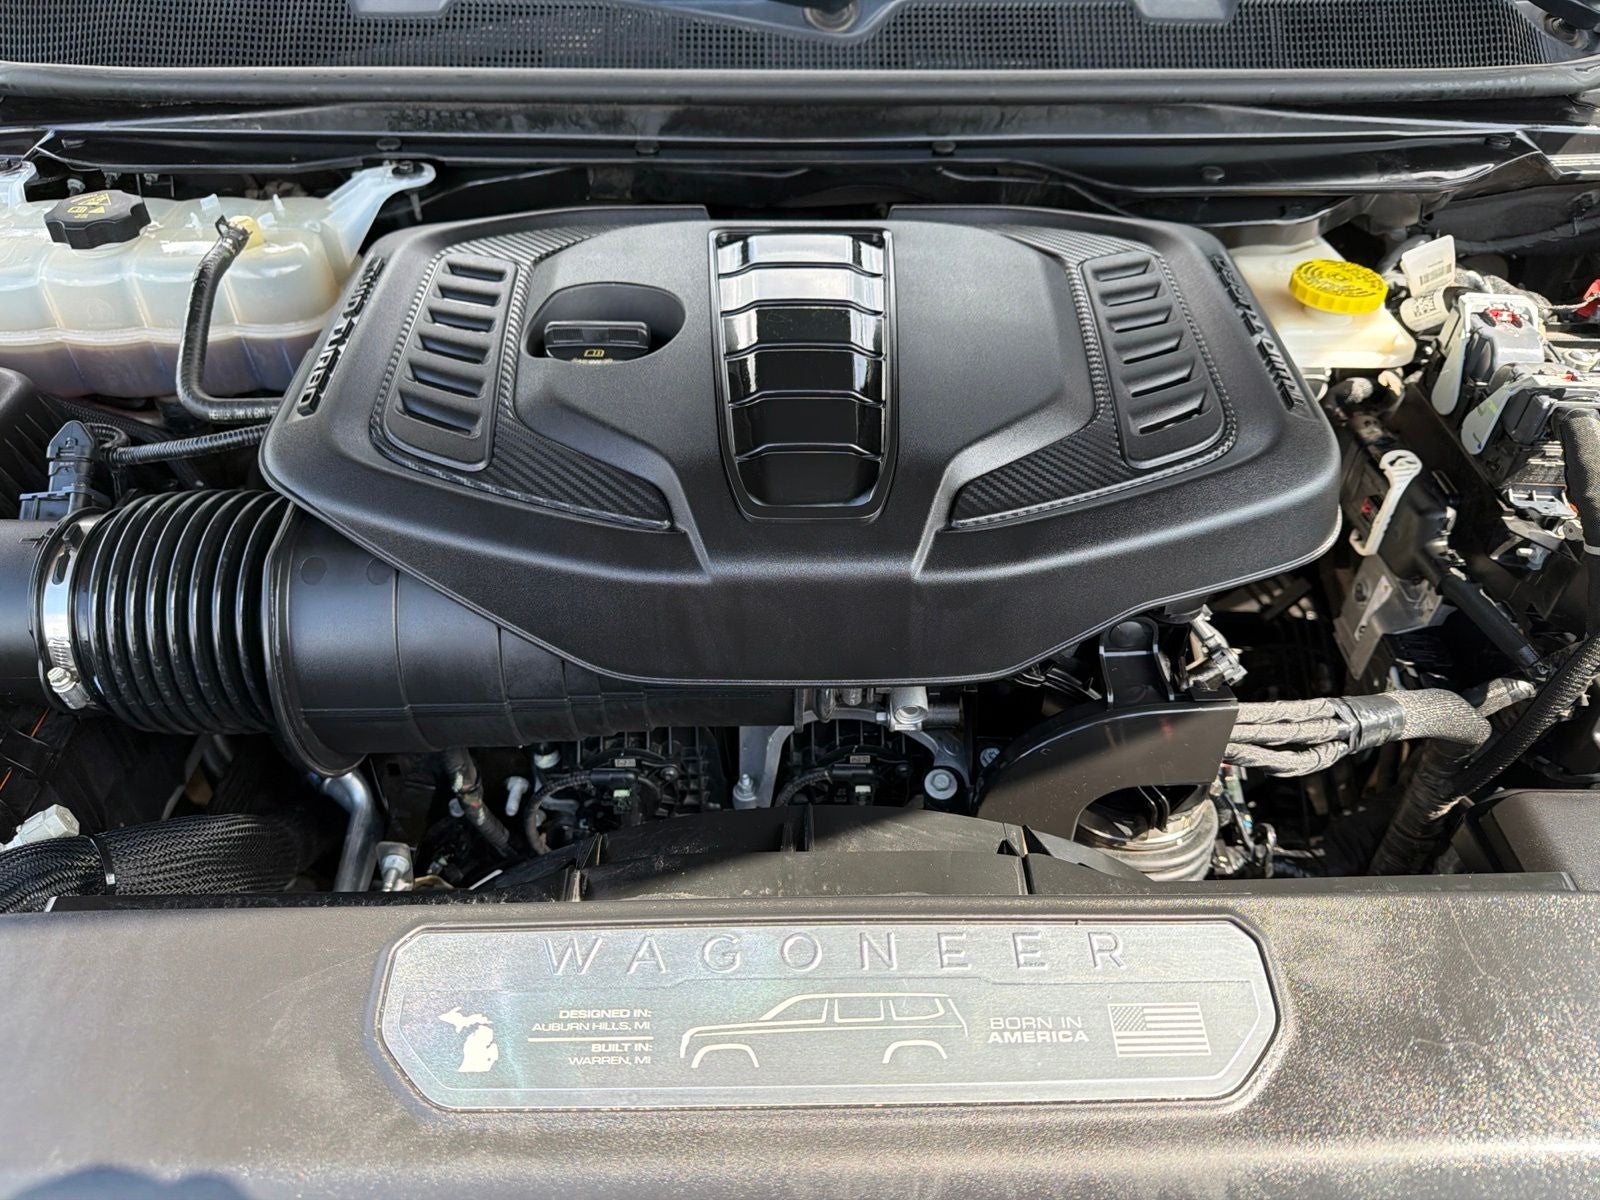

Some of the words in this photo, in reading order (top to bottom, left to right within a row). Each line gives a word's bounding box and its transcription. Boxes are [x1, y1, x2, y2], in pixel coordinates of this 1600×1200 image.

[1210, 255, 1265, 337] TURBO
[297, 316, 356, 418] TURBO
[542, 932, 1127, 976] WAGONEER
[558, 1009, 631, 1019] DESIGNED
[633, 1008, 653, 1018] IN:
[531, 1022, 590, 1032] AUBURN
[591, 1021, 632, 1031] HILLS,
[633, 1021, 651, 1030] MI
[990, 1016, 1053, 1030] BORN
[1061, 1015, 1083, 1029] IN
[987, 1030, 1090, 1044] AMERICA
[591, 1043, 632, 1053] BUILT
[634, 1042, 653, 1052] IN:
[567, 1056, 632, 1066] WARREN,
[634, 1055, 652, 1065] MI
